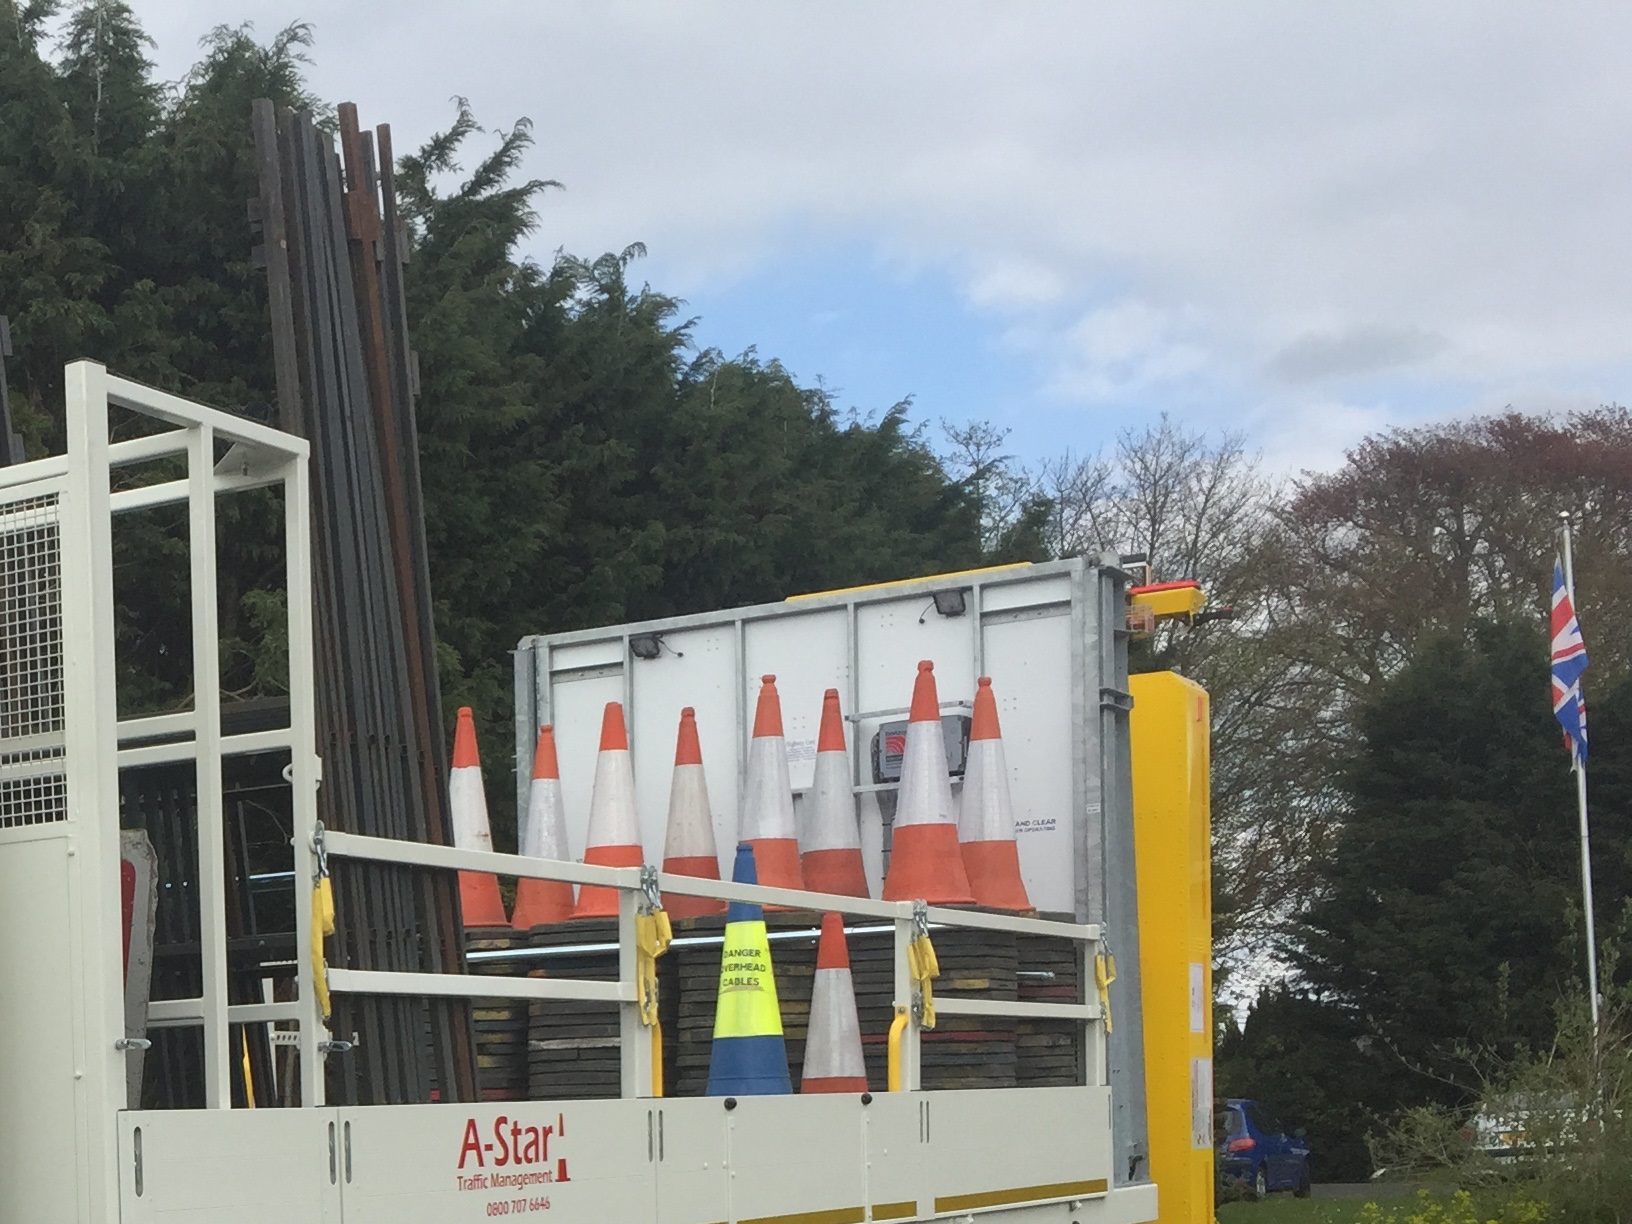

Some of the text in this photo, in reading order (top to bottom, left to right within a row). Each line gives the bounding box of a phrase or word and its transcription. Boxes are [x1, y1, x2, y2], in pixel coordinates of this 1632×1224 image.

[1032, 818, 1056, 826] CLEAR
[723, 948, 761, 958] DANGER
[722, 977, 760, 987] CABLES
[457, 1115, 554, 1169] A-Star
[456, 1169, 554, 1192] Traffic Management
[486, 1200, 509, 1217] 0800
[511, 1198, 528, 1214] 707
